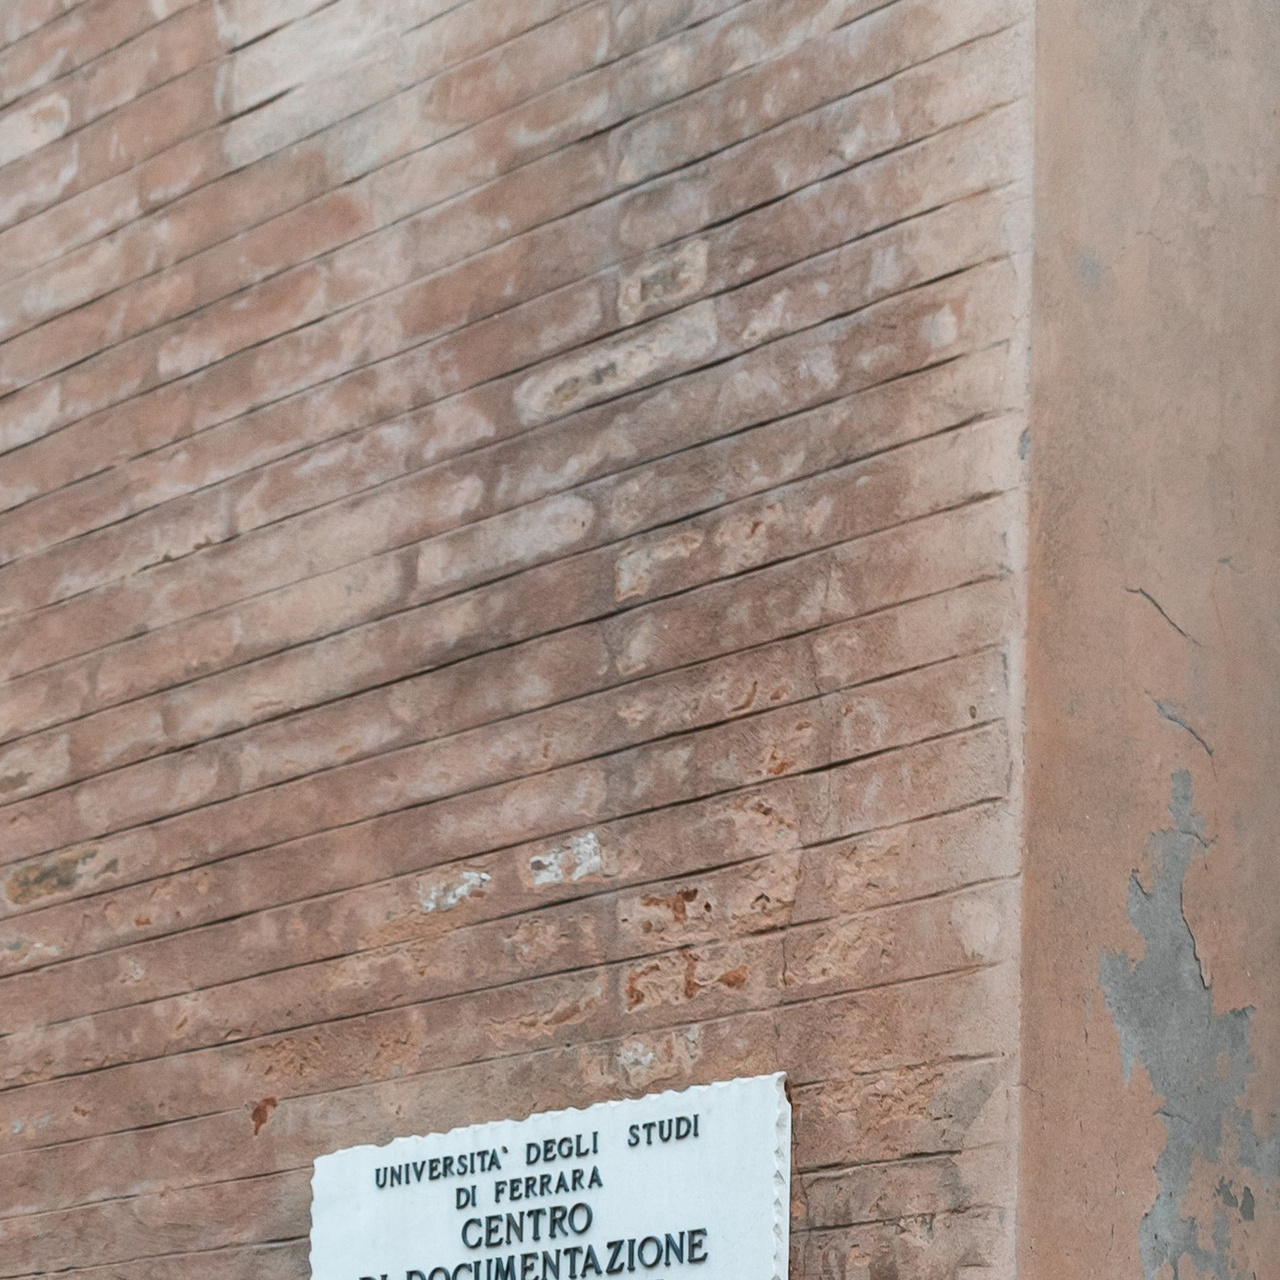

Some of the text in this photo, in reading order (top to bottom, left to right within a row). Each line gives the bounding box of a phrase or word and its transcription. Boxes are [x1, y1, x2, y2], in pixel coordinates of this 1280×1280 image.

[525, 1130, 599, 1167] DEGLI
[627, 1113, 700, 1148] STUDI
[455, 1165, 604, 1211] DI FERRARA
[461, 1202, 594, 1251] CENTRO
